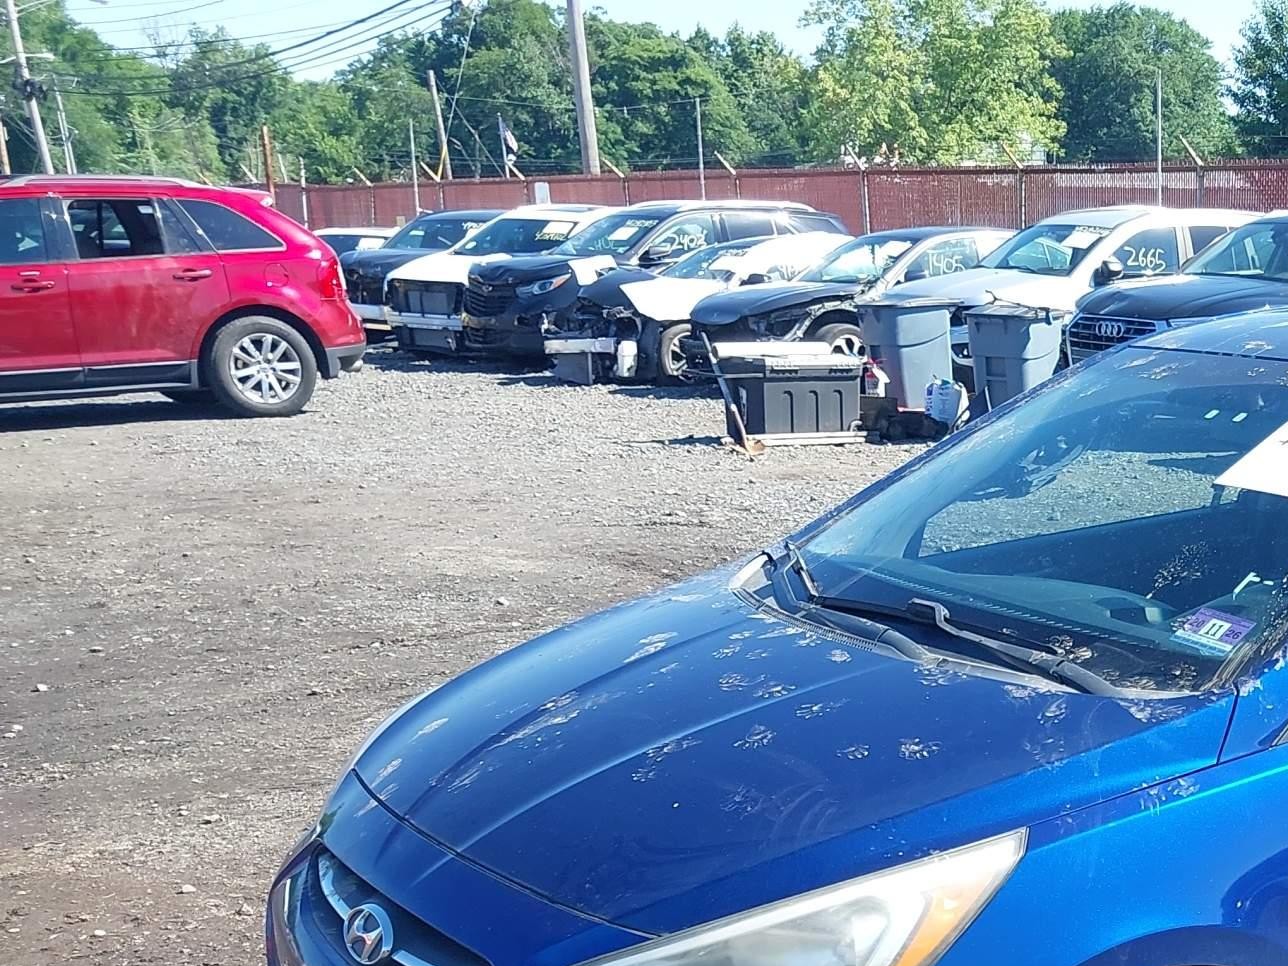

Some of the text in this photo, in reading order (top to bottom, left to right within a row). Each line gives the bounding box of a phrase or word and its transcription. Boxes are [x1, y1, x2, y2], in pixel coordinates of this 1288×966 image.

[928, 253, 966, 275] 1405
[1123, 246, 1166, 273] 2665
[1204, 622, 1224, 638] 11
[1225, 629, 1242, 640] 26
